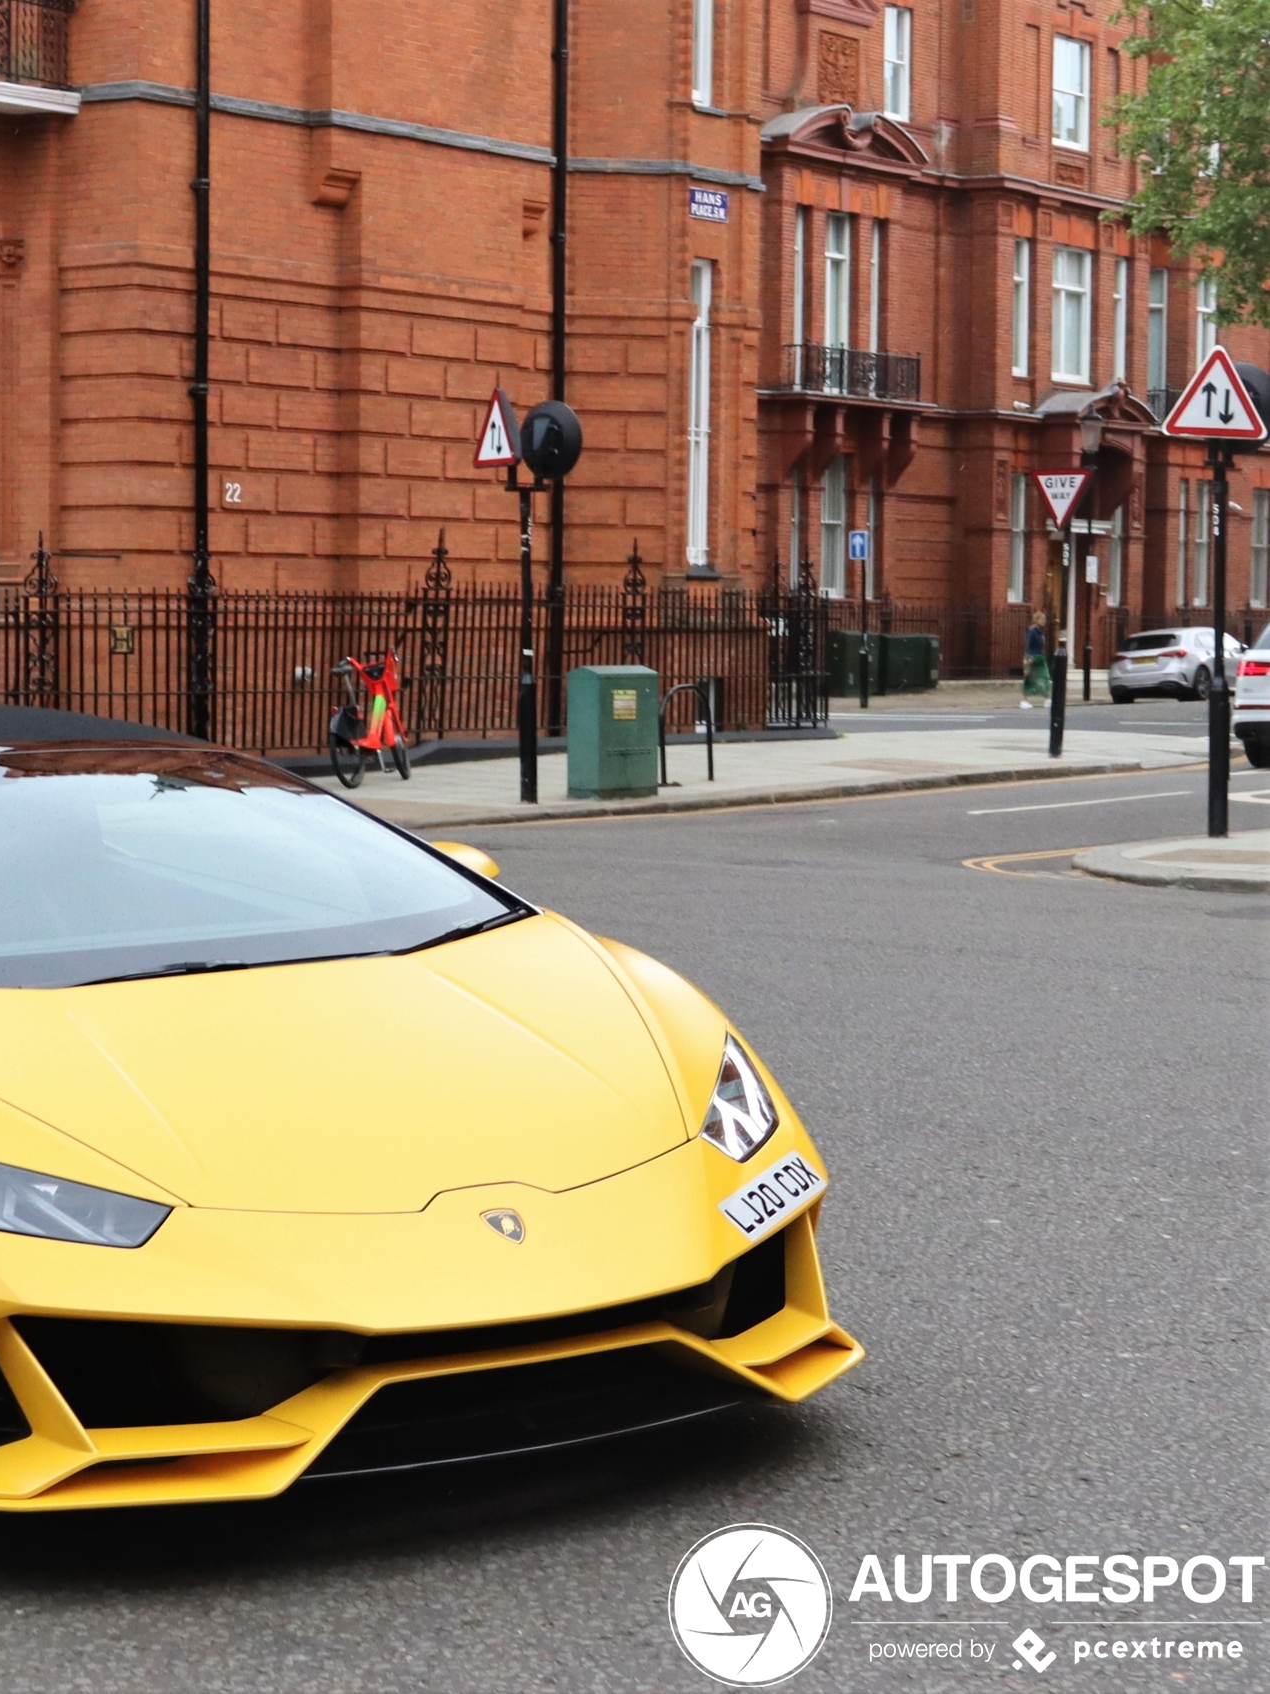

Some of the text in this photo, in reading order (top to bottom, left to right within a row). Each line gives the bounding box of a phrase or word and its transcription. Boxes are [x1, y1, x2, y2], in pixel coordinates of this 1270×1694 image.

[694, 190, 723, 207] HANS
[1044, 476, 1077, 489] GIVE
[225, 482, 241, 503] 22
[1051, 491, 1071, 500] WAY
[724, 1157, 820, 1234] LJ20 CDX
